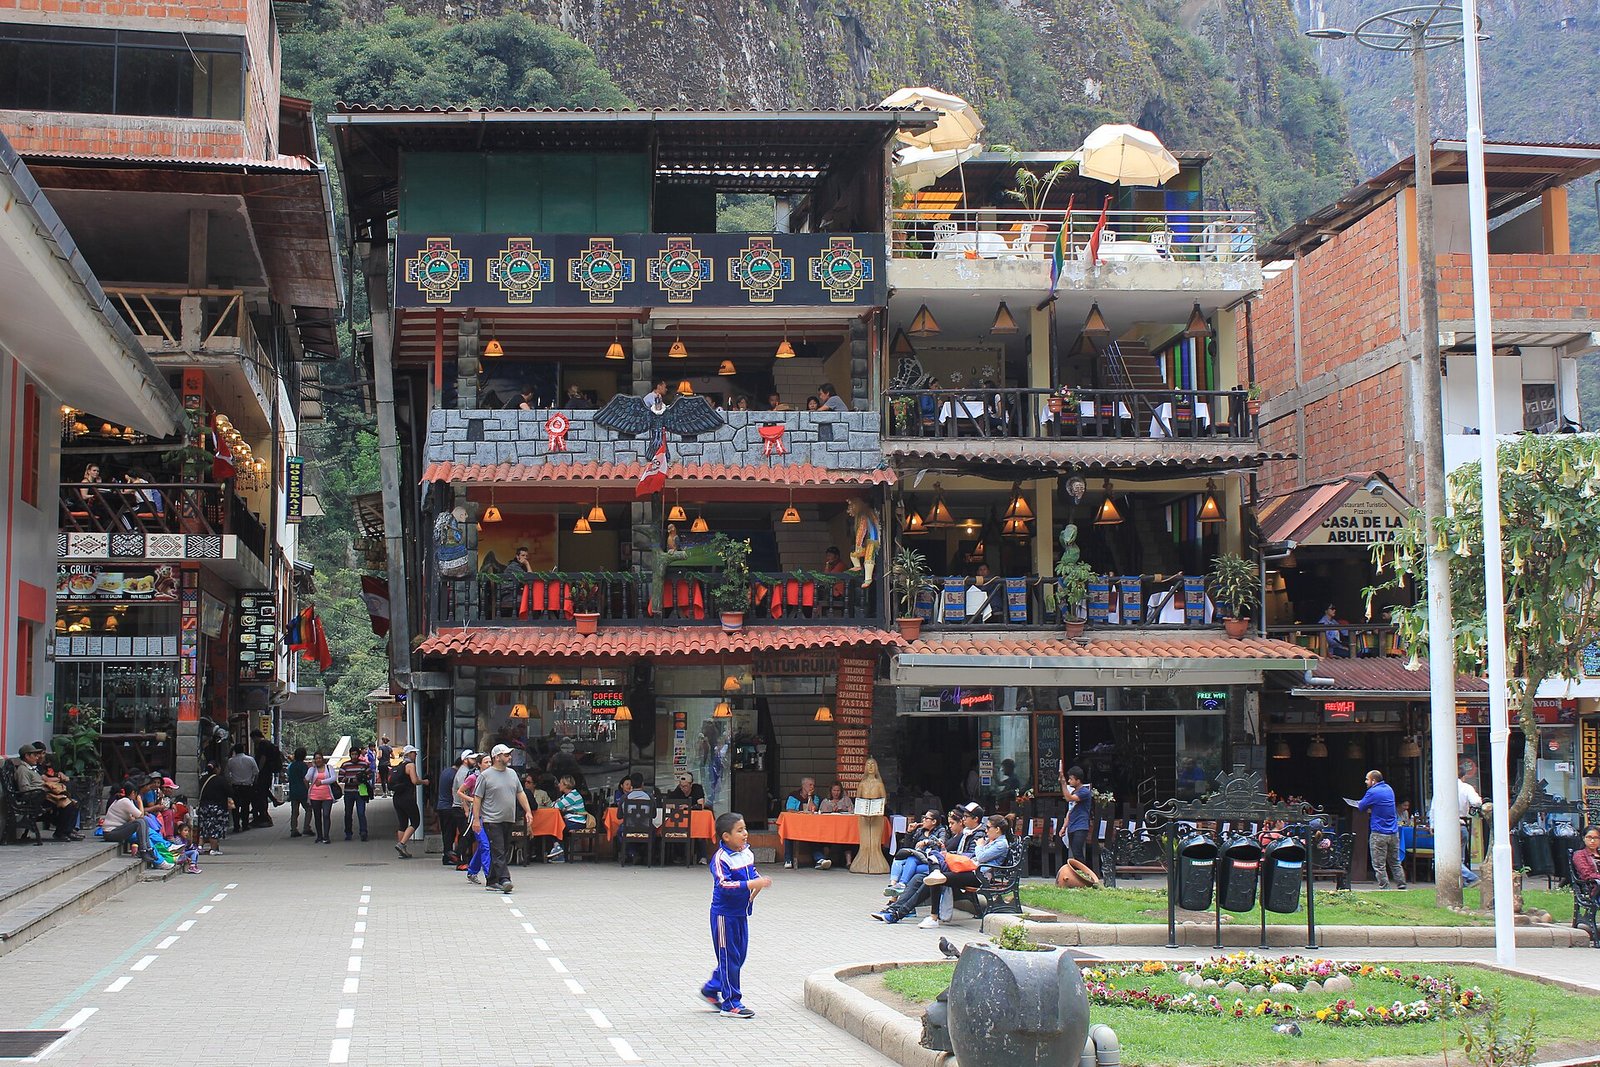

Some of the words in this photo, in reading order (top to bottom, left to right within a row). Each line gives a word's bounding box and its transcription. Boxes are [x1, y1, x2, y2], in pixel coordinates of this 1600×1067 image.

[289, 463, 300, 516] HOSPEDAJE
[1321, 516, 1359, 529] CASA
[1362, 516, 1381, 529] DE
[1385, 516, 1404, 529] LA
[1327, 530, 1397, 543] ABUELITA
[70, 564, 93, 574] GRILL
[592, 692, 623, 700] COFFEE
[928, 700, 939, 708] TAX
[1583, 721, 1597, 775] LAUNDRY
